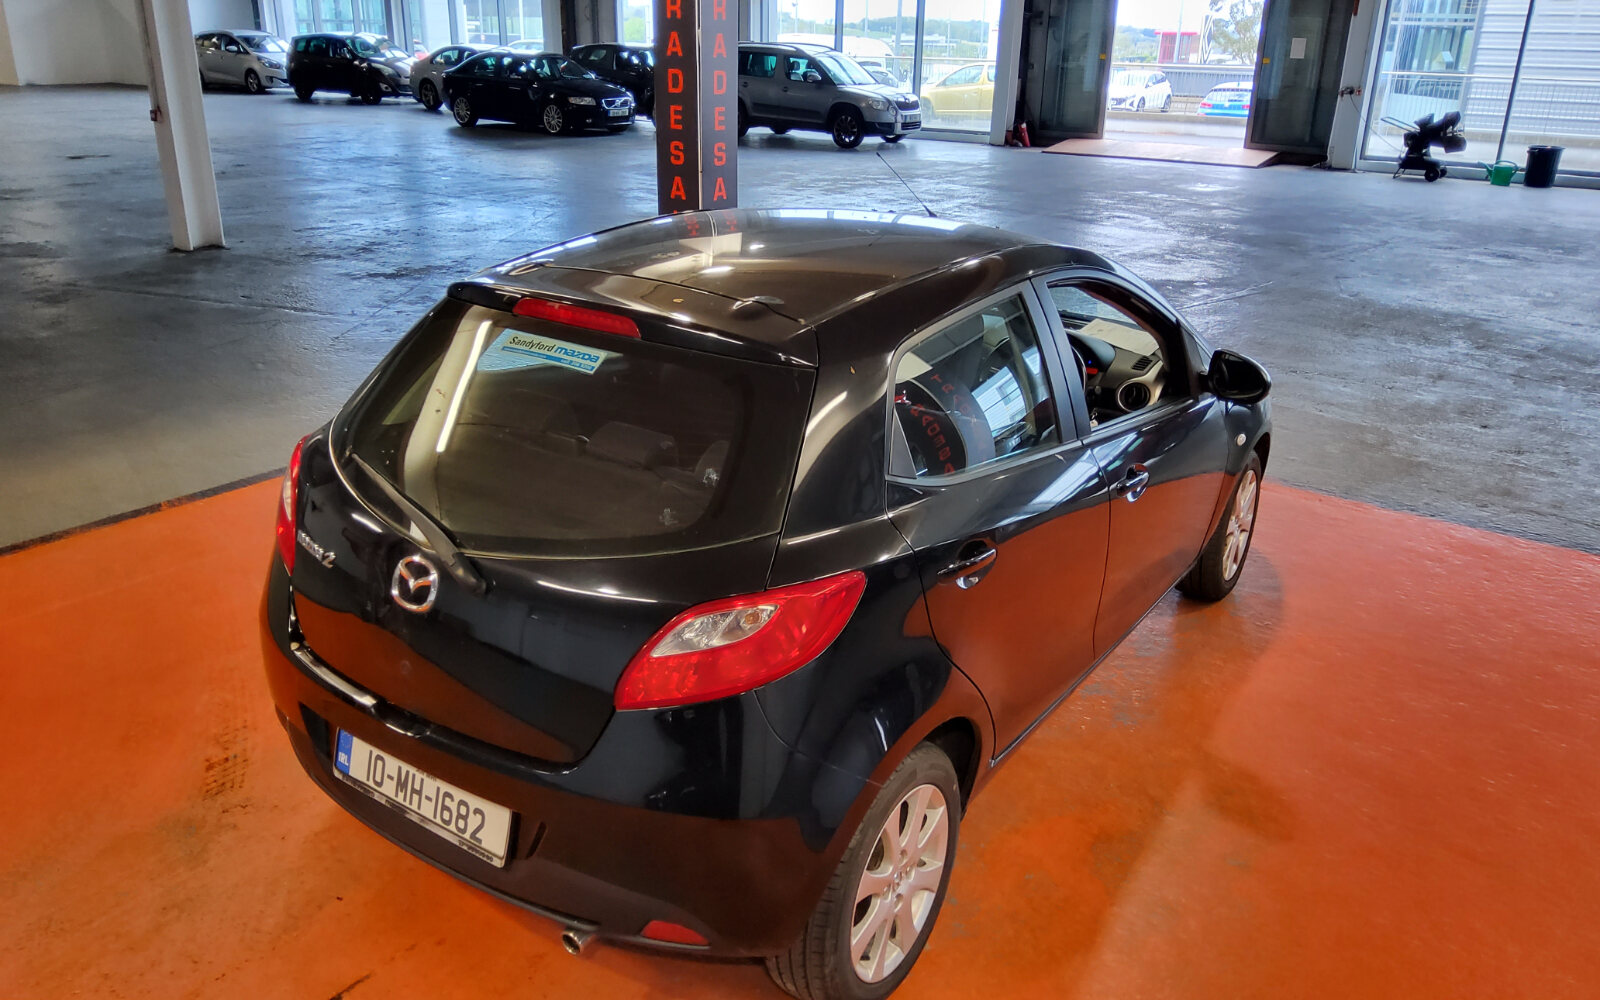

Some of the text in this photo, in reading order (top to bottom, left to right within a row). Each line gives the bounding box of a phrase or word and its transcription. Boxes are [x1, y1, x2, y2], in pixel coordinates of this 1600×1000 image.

[666, 0, 687, 214] RADESA
[509, 336, 556, 352] Sandyford
[554, 345, 600, 363] mazda
[338, 751, 349, 767] IRL
[366, 749, 486, 846] 10-MH-1682
